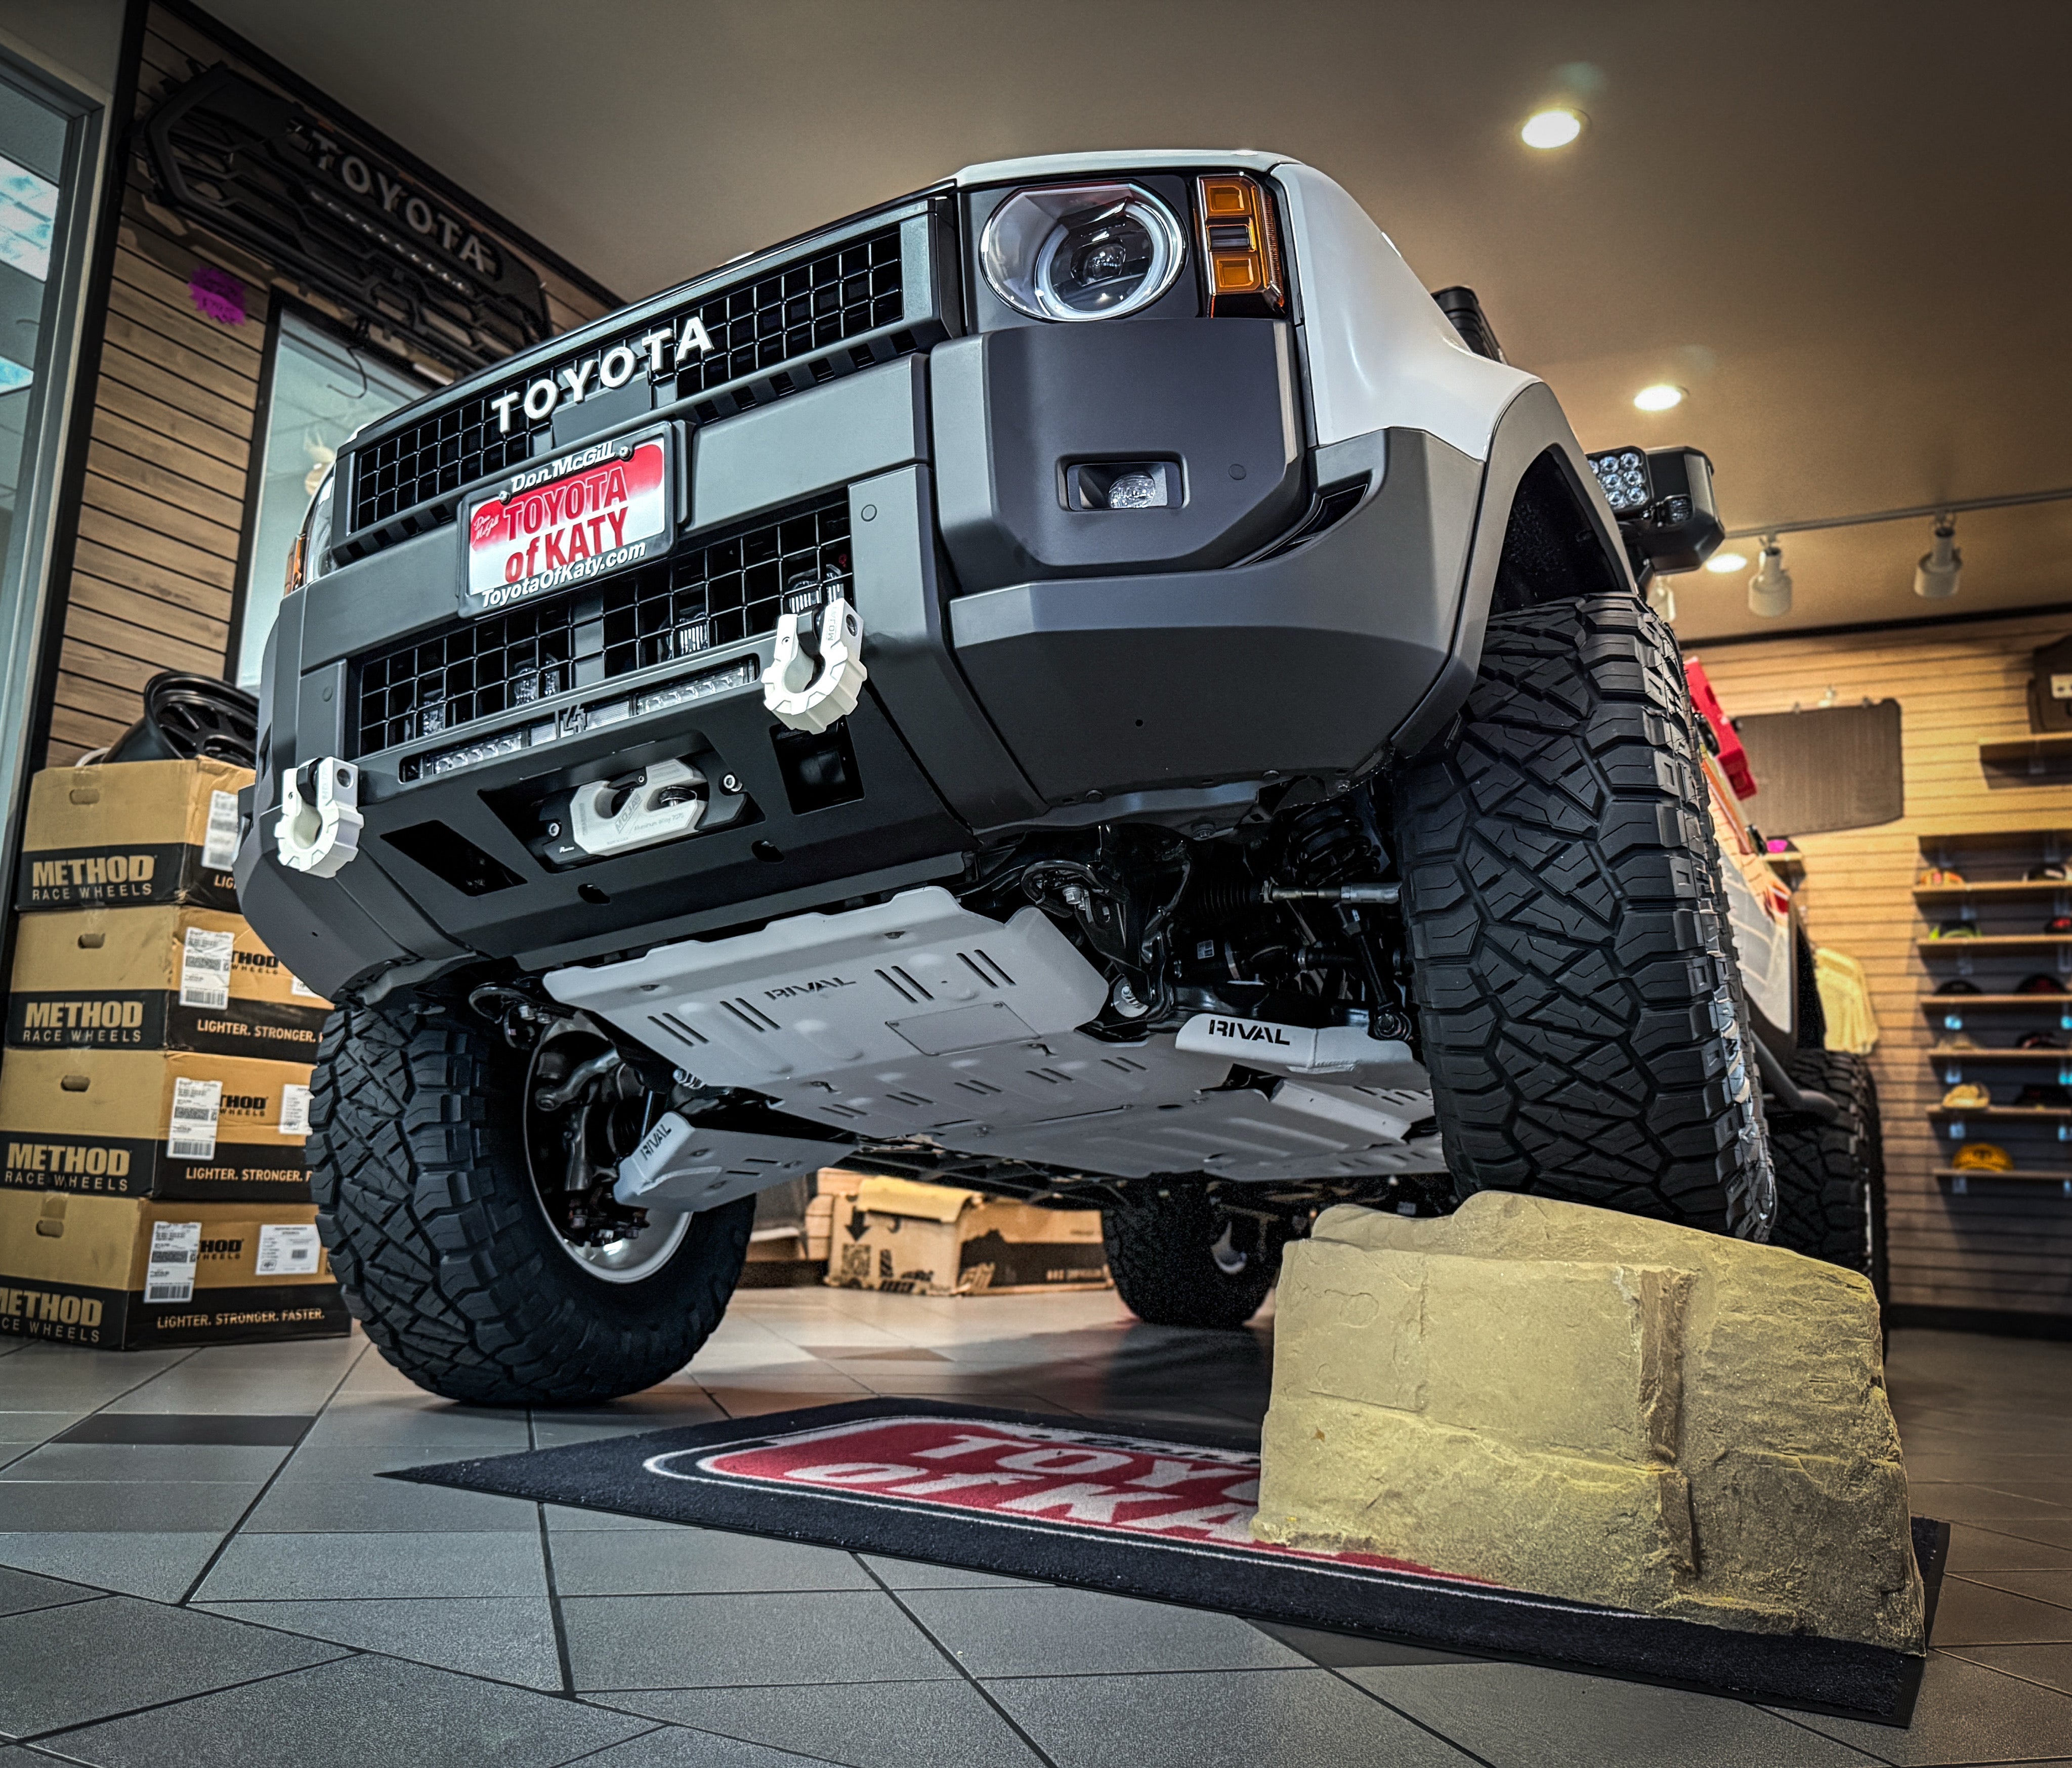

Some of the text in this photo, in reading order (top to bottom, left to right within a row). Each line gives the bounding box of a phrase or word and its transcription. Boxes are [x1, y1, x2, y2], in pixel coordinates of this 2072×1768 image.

[312, 131, 485, 273] TOYOTA
[491, 316, 714, 434] TOYOTA
[511, 441, 615, 494] Don McGill
[503, 466, 628, 541] TOYOTA
[505, 506, 629, 584] of KATY
[482, 542, 646, 607] ToyotaOfKaty.com
[32, 855, 154, 887] METHOD
[32, 883, 152, 901] RACE WHEELS
[764, 977, 857, 1001] RIVAL
[25, 1001, 143, 1028] METHOD
[23, 1029, 142, 1042] RACE WHEELS
[197, 1019, 251, 1036] LIGHTER.
[254, 1025, 316, 1043] STRONGER.
[1208, 1019, 1290, 1046] RIVAL
[640, 1124, 672, 1161] RIVAL
[7, 1142, 131, 1177] METHOD
[5, 1170, 128, 1192] RACE WHEELS
[186, 1167, 238, 1181] LIGHTER.
[242, 1169, 303, 1182] STRONGER.
[157, 1308, 325, 1329] LIGHTER. STRONGER. FASTER.
[29, 1321, 100, 1344] WHEELS
